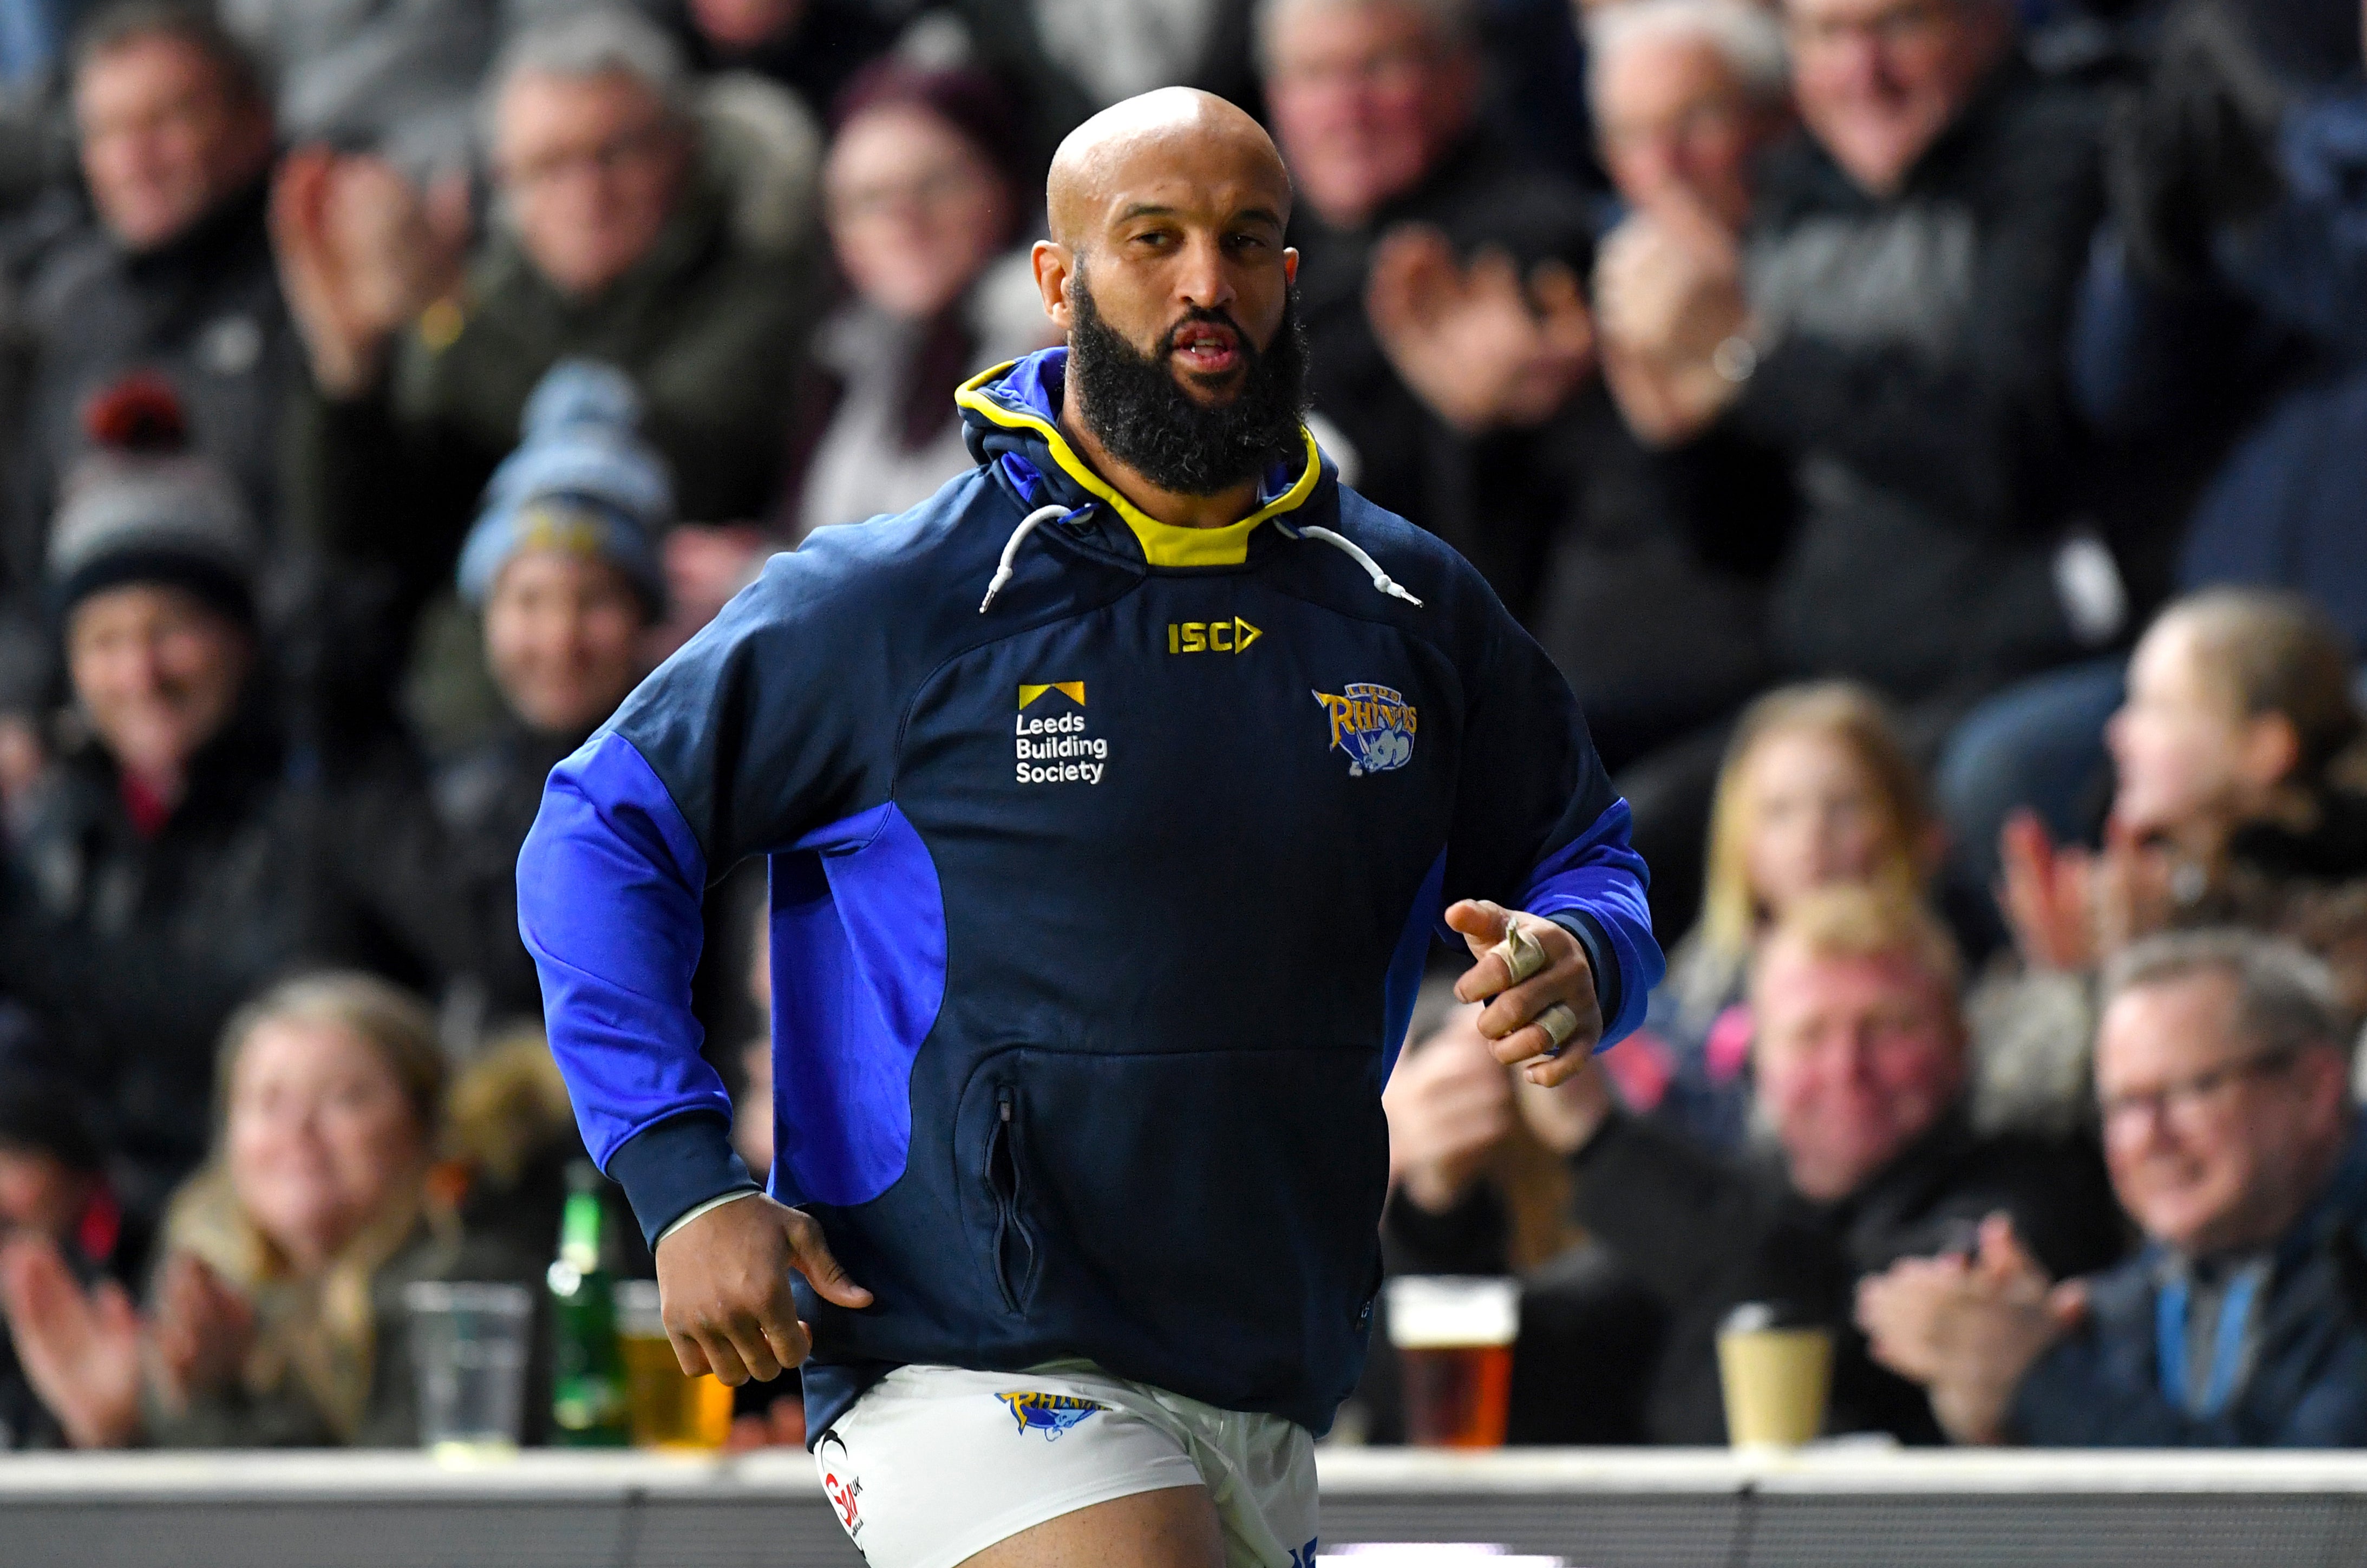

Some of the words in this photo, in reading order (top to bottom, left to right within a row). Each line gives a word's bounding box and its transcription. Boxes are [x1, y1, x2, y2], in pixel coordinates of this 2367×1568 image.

[1168, 622, 1232, 654] ISC
[1348, 684, 1399, 702] LEEDS
[1016, 711, 1086, 735] Leeds
[1016, 735, 1108, 759] Building
[1016, 761, 1104, 785] Society
[849, 1475, 864, 1497] UK
